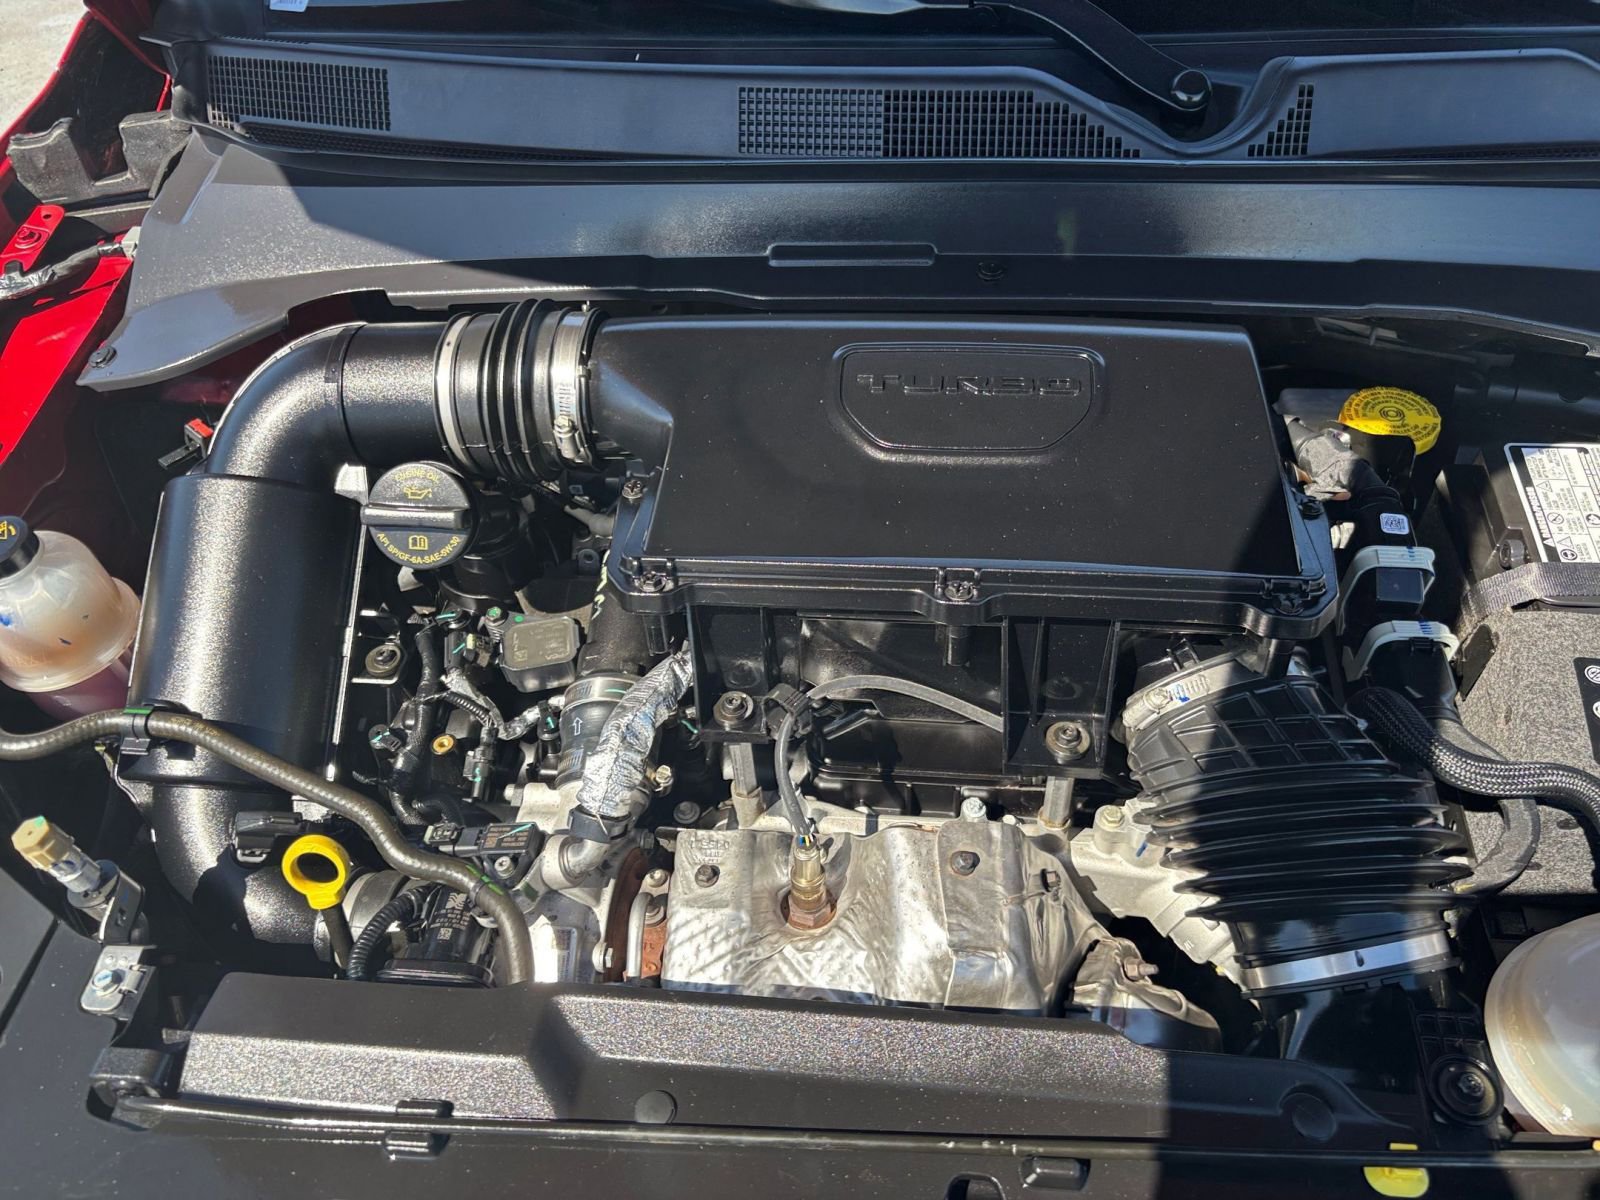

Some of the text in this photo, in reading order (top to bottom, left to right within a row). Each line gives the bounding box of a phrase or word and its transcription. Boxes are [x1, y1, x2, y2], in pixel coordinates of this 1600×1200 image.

[857, 374, 1082, 396] TURBO
[395, 469, 440, 483] ENGINE OIL
[377, 533, 390, 547] API
